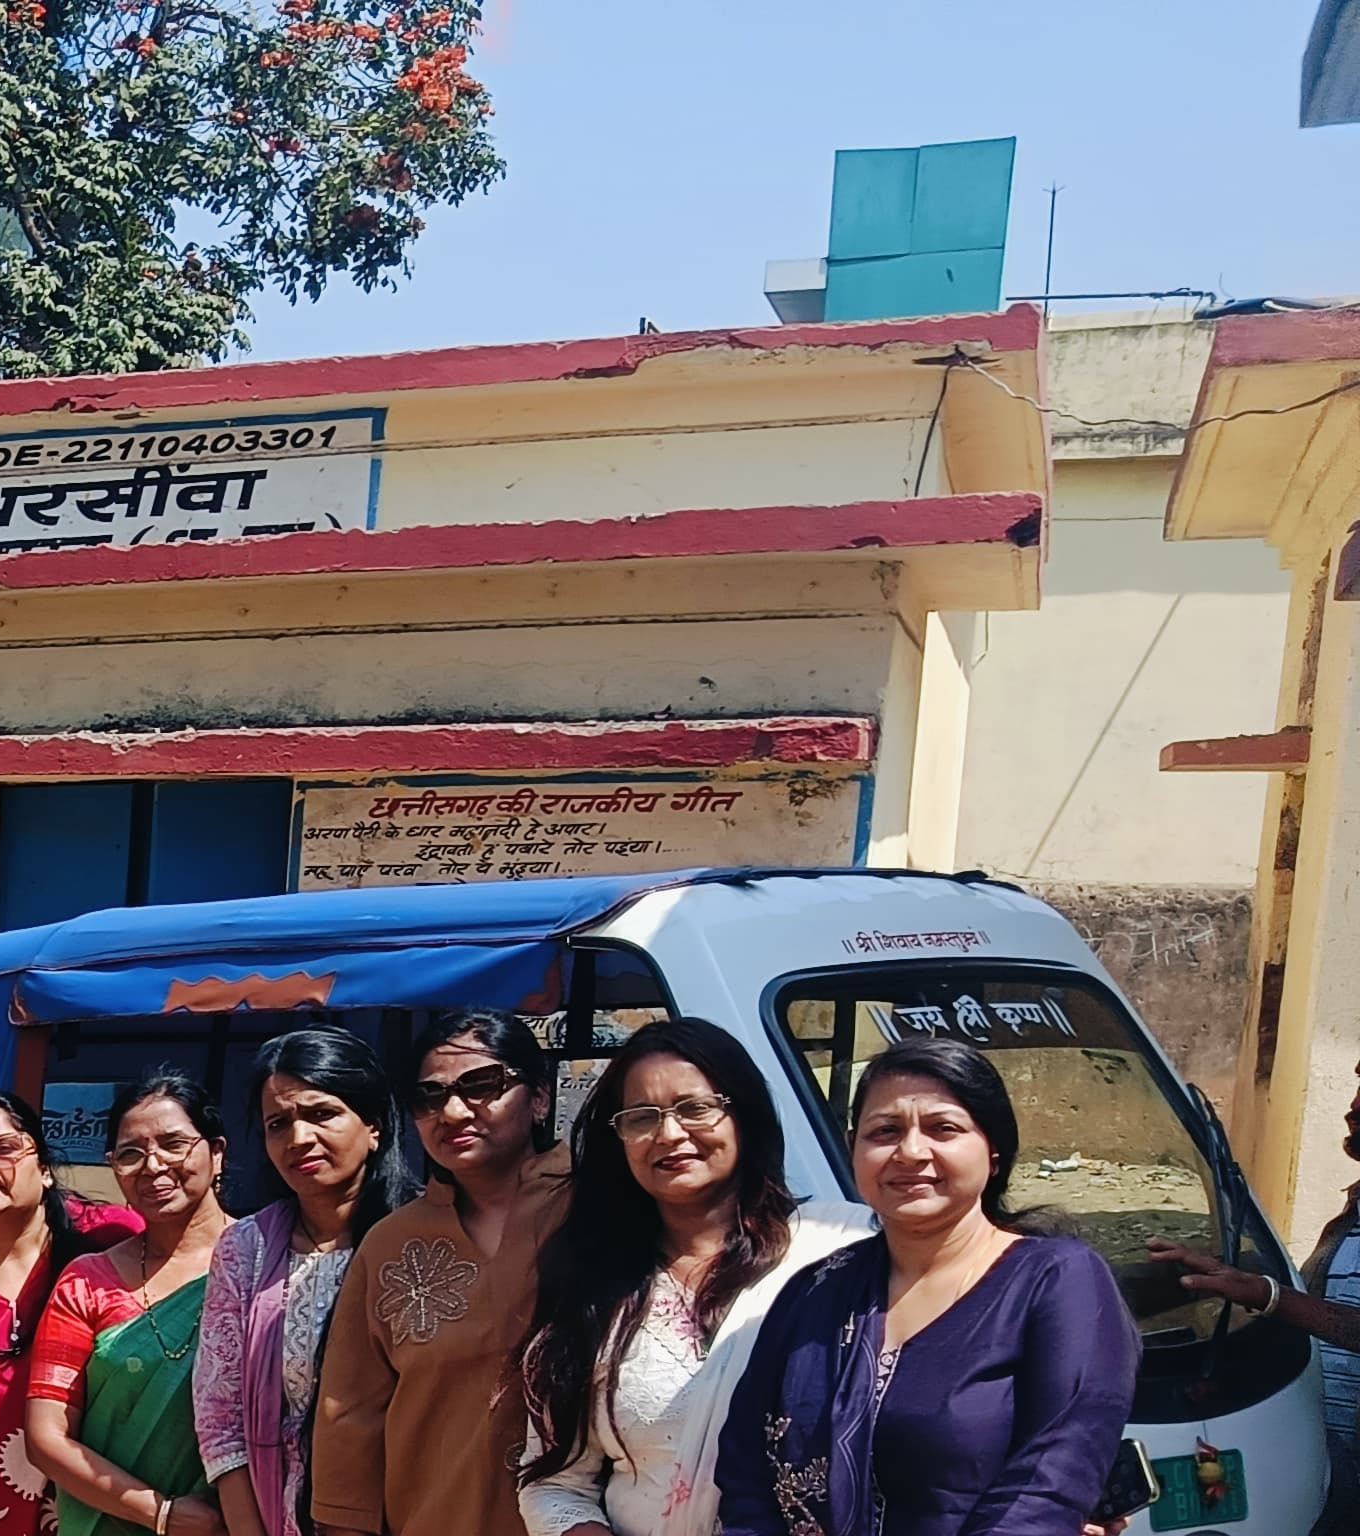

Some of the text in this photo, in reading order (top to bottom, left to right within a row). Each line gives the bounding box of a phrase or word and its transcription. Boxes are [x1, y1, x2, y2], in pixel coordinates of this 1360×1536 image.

[496, 788, 539, 815] की
[540, 786, 666, 815] राजकीय
[670, 785, 744, 813] गीत
[303, 826, 351, 840] अरपा
[384, 821, 404, 839] के
[406, 825, 445, 839] धार
[563, 836, 598, 856] तोर
[438, 857, 471, 876] तोर
